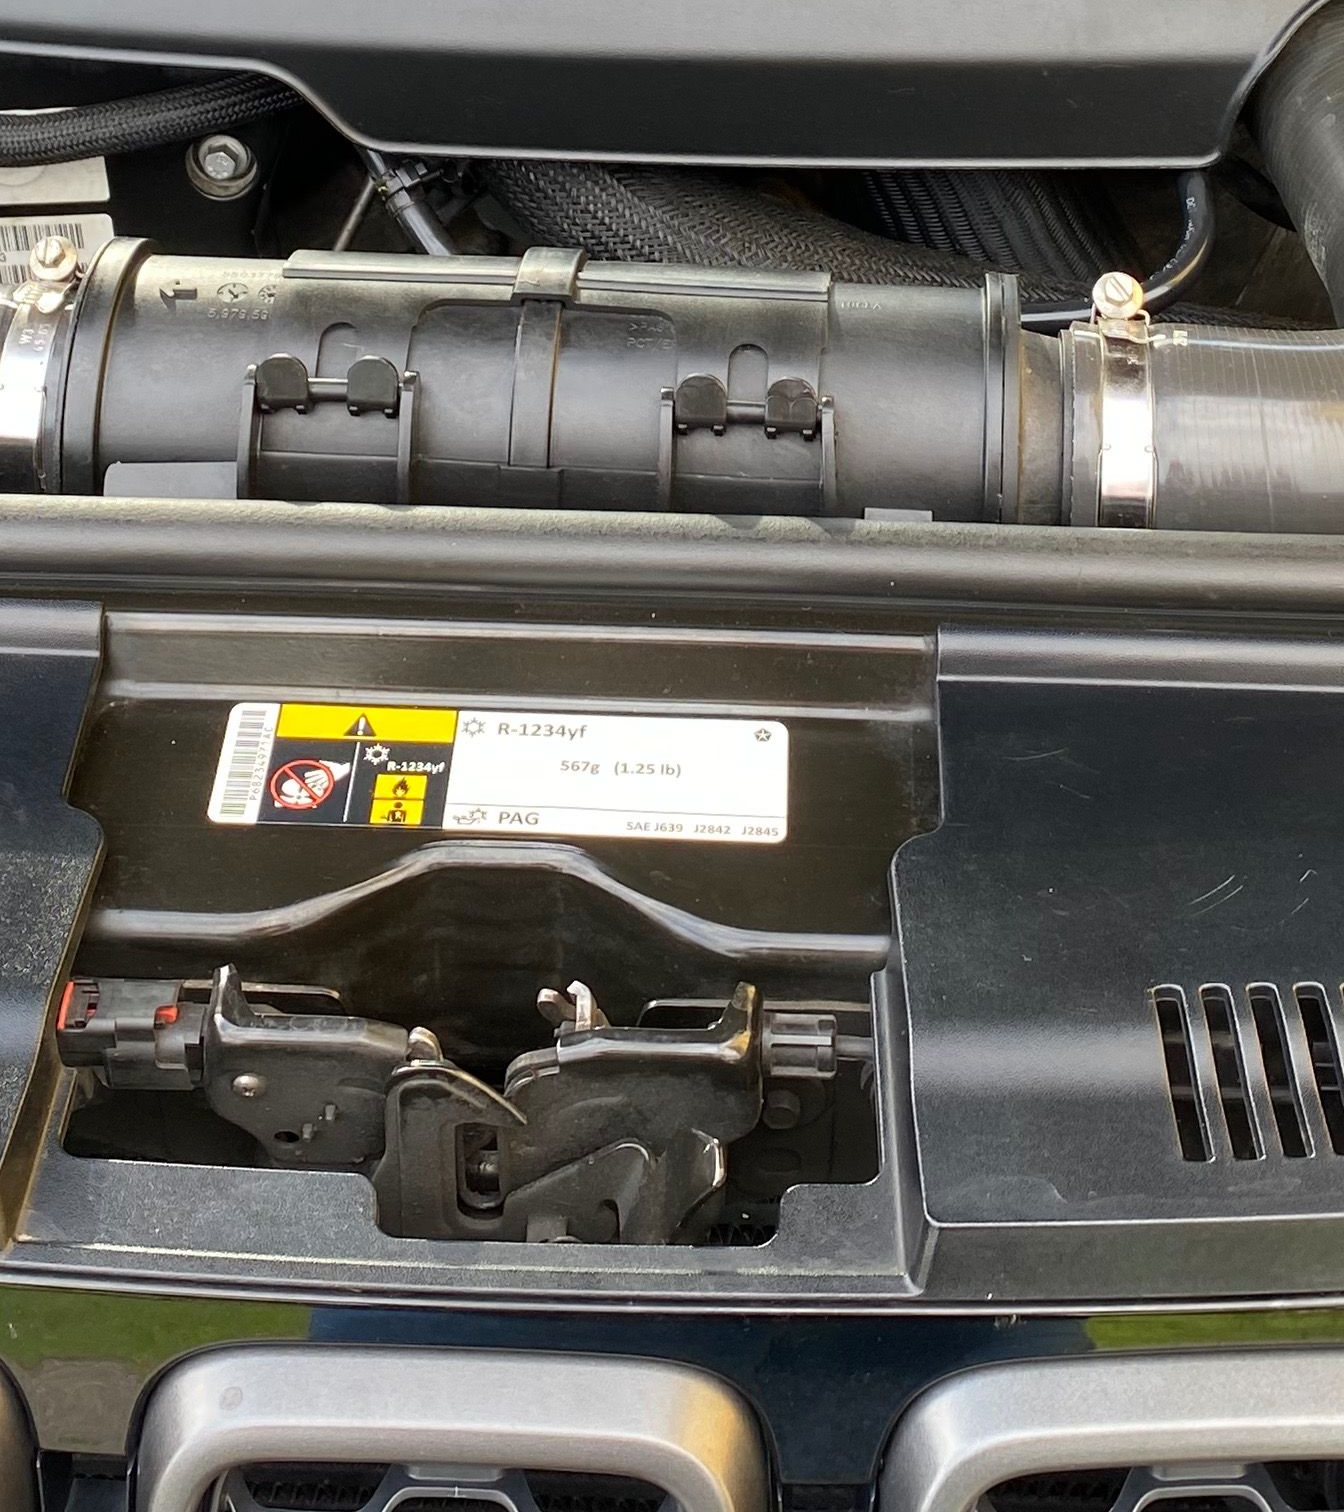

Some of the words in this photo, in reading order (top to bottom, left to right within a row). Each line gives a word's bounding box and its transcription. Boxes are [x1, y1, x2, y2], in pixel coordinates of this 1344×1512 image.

[497, 722, 588, 741] R-1234yf
[386, 760, 446, 776] R-1234yf
[559, 760, 601, 775] 567g
[613, 761, 656, 776] (1.25
[660, 762, 683, 778] lb)
[498, 810, 540, 826] PAG
[626, 821, 651, 832] SAE
[653, 822, 683, 833] J639
[693, 824, 731, 835] J2842
[741, 826, 779, 837] J2845
